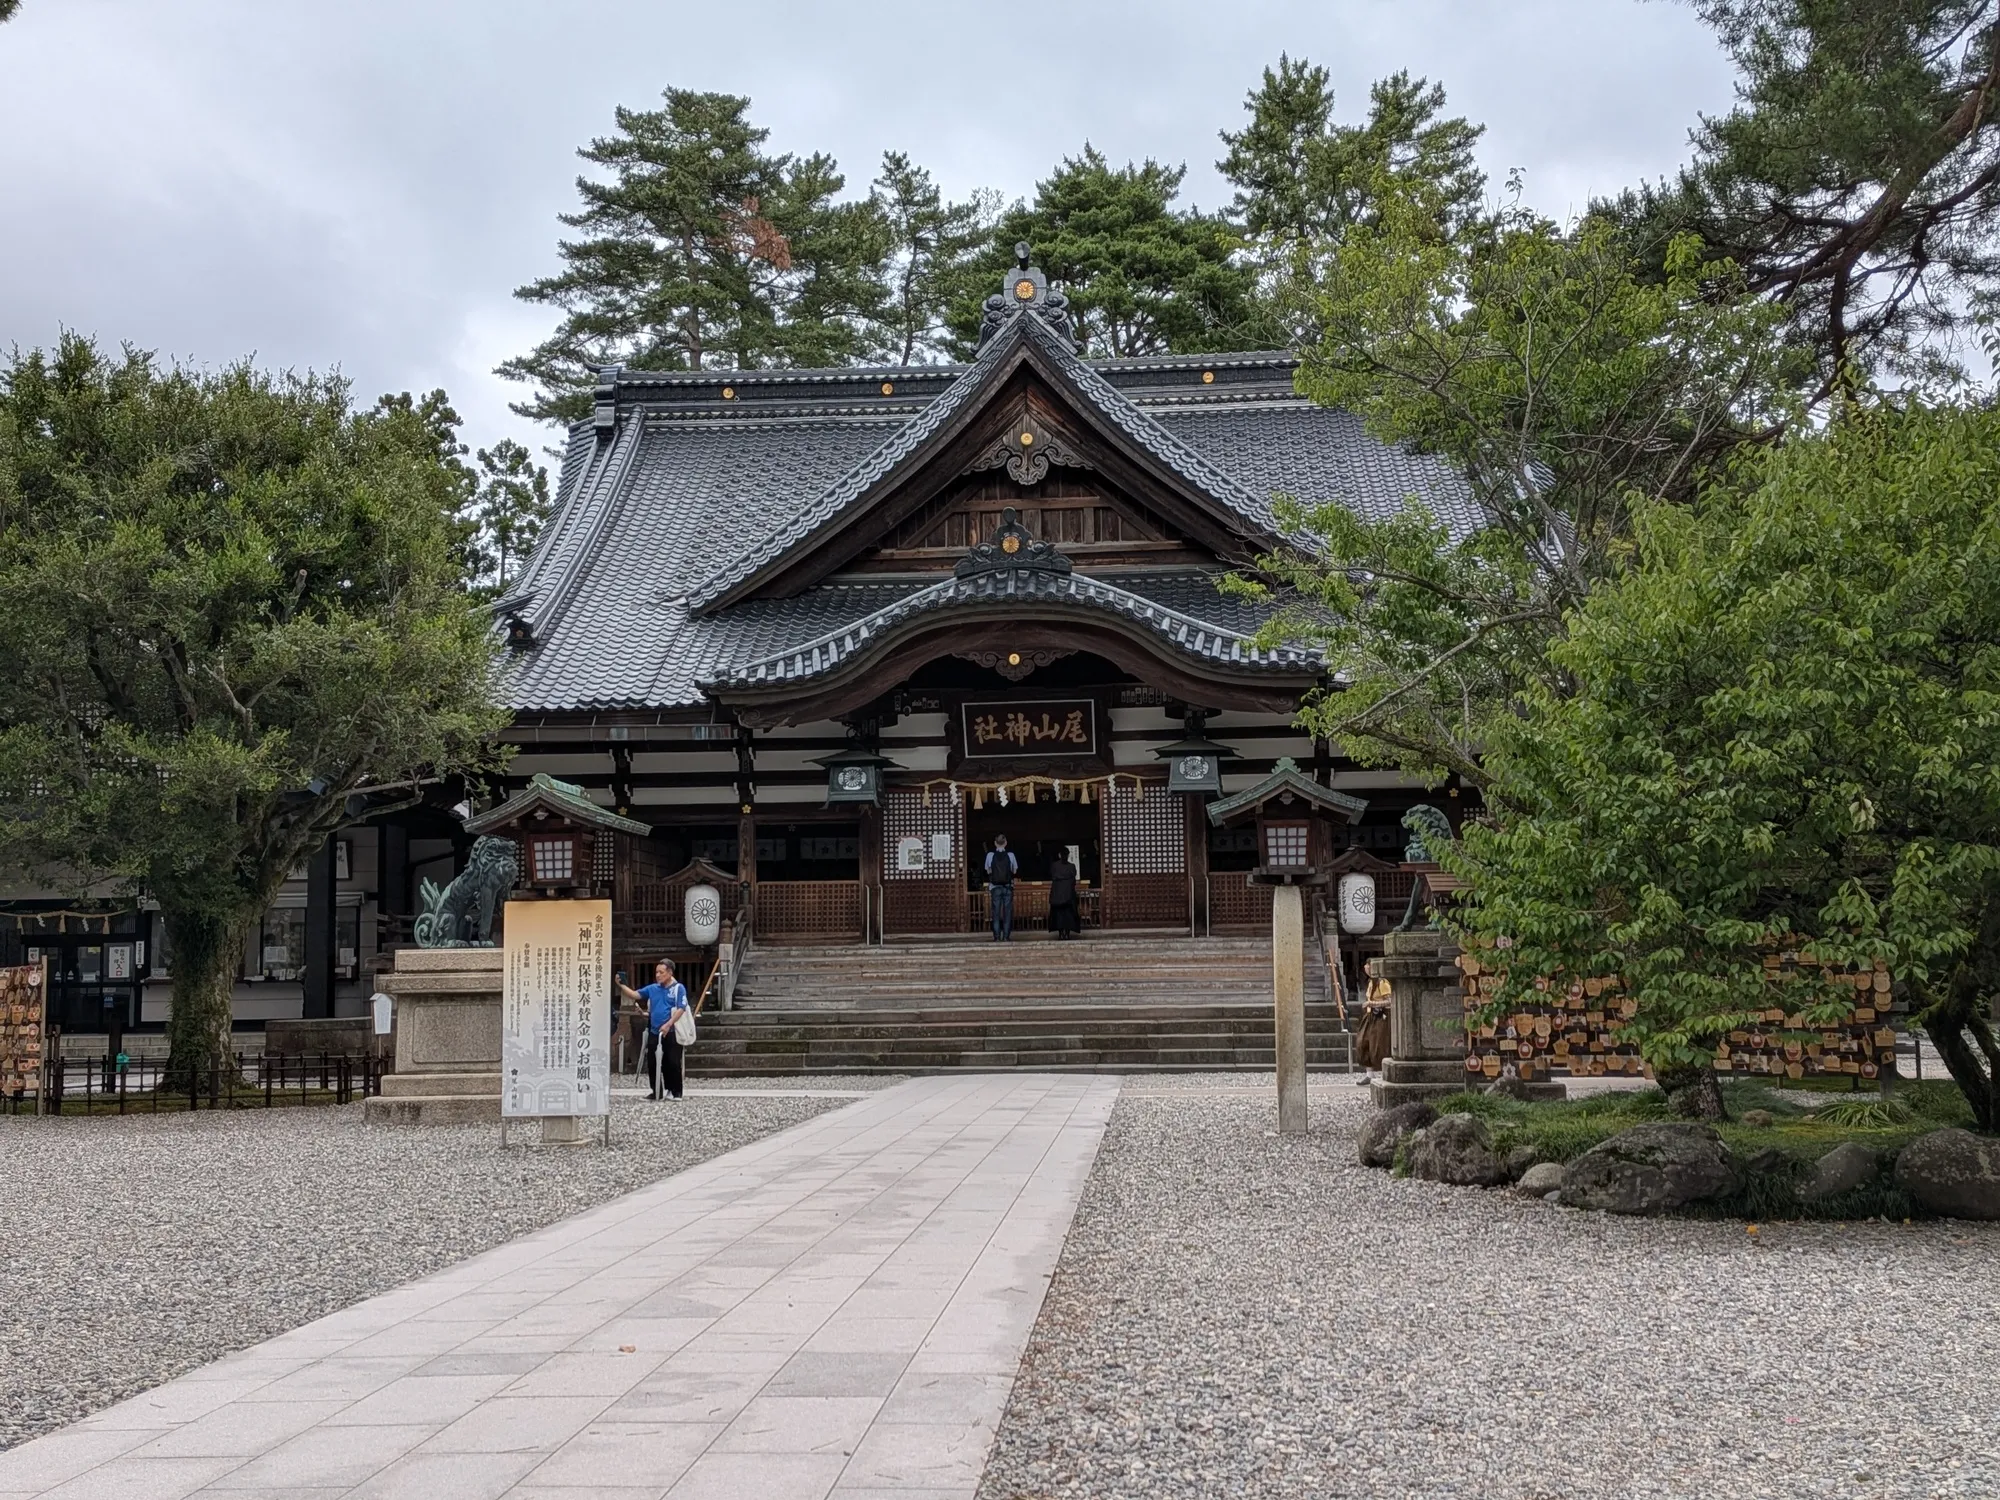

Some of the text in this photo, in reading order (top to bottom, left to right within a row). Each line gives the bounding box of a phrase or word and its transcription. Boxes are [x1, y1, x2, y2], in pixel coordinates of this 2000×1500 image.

[972, 710, 1088, 748] 尾山神社
[594, 914, 604, 997] 金沢の遺産を後世まで
[523, 992, 530, 1006] 千円
[577, 921, 592, 1093] 『神門』保持奉賛金のお願い
